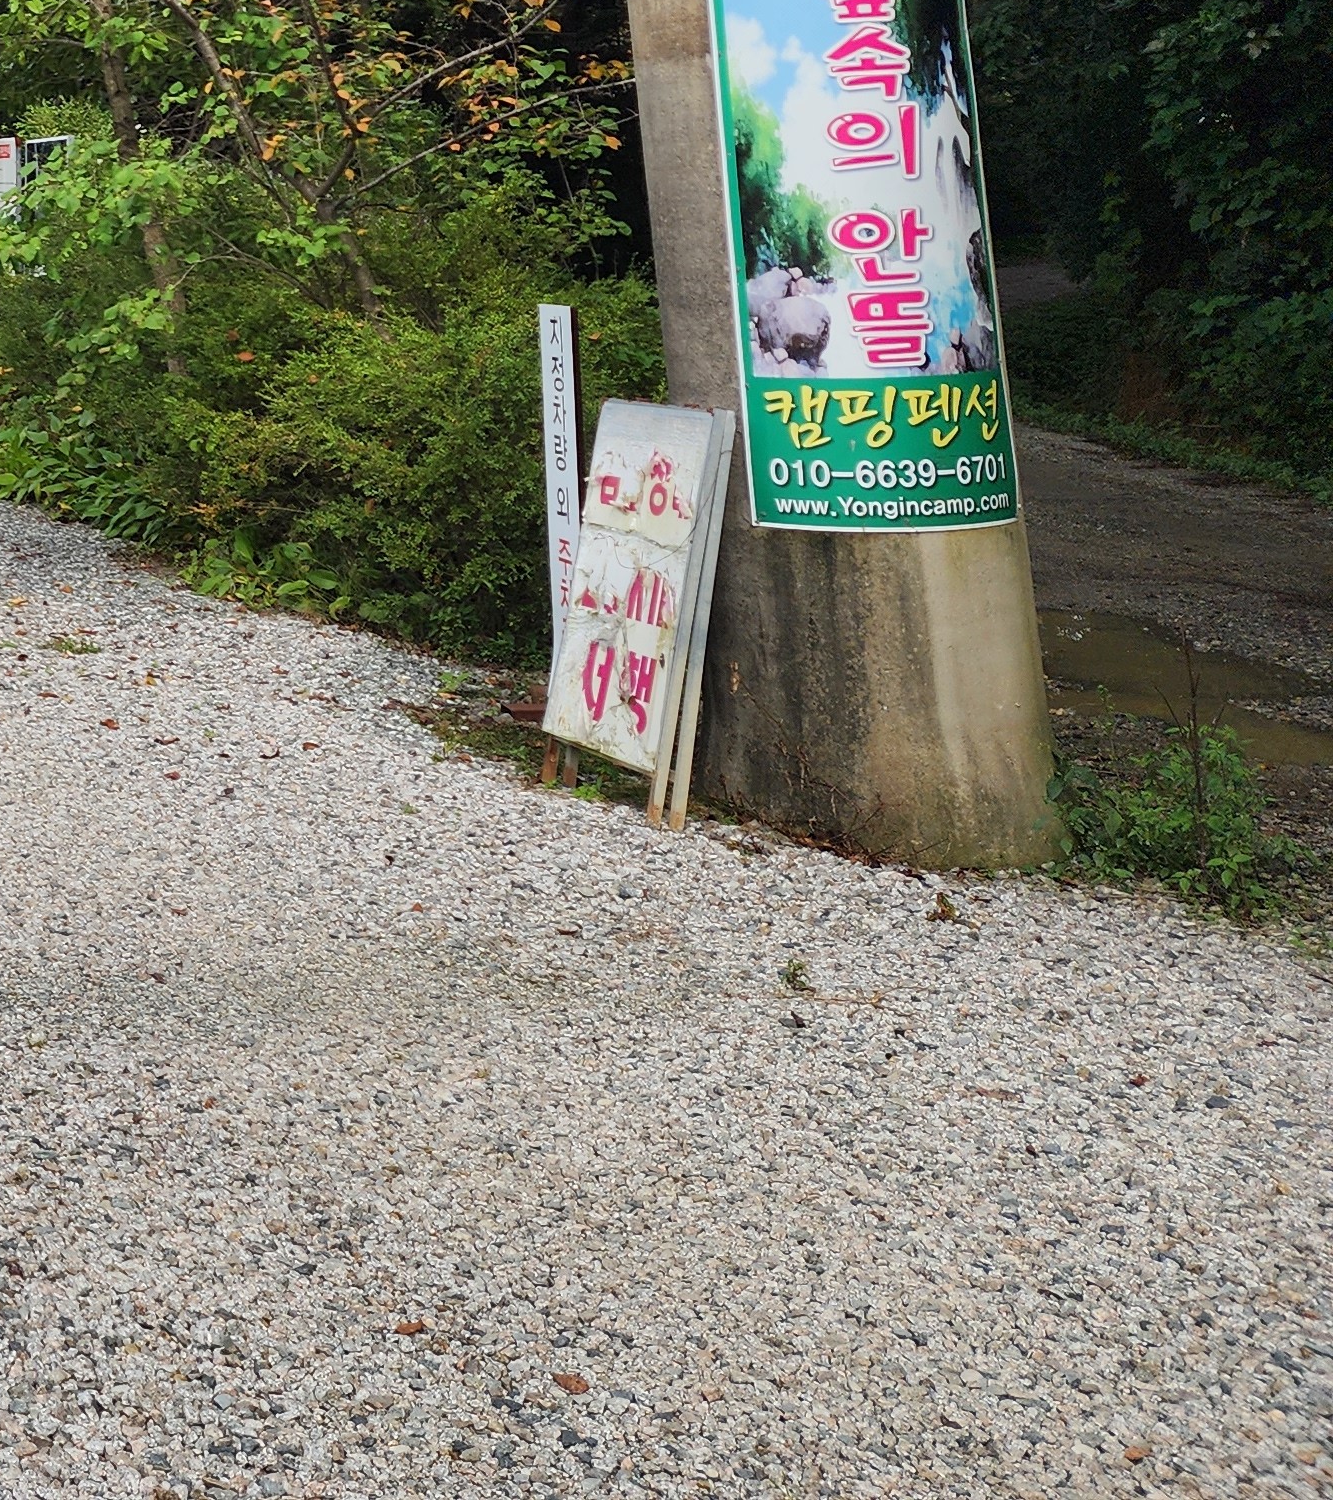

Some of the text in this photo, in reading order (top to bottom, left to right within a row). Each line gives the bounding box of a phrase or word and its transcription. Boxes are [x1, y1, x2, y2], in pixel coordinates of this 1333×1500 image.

[829, 207, 933, 368] 안뜰
[763, 378, 1001, 450] 캠핑펜션
[770, 452, 1008, 489] 010-6639-6701
[556, 486, 571, 526] 외
[774, 492, 1010, 520] www.Yongincamp.com
